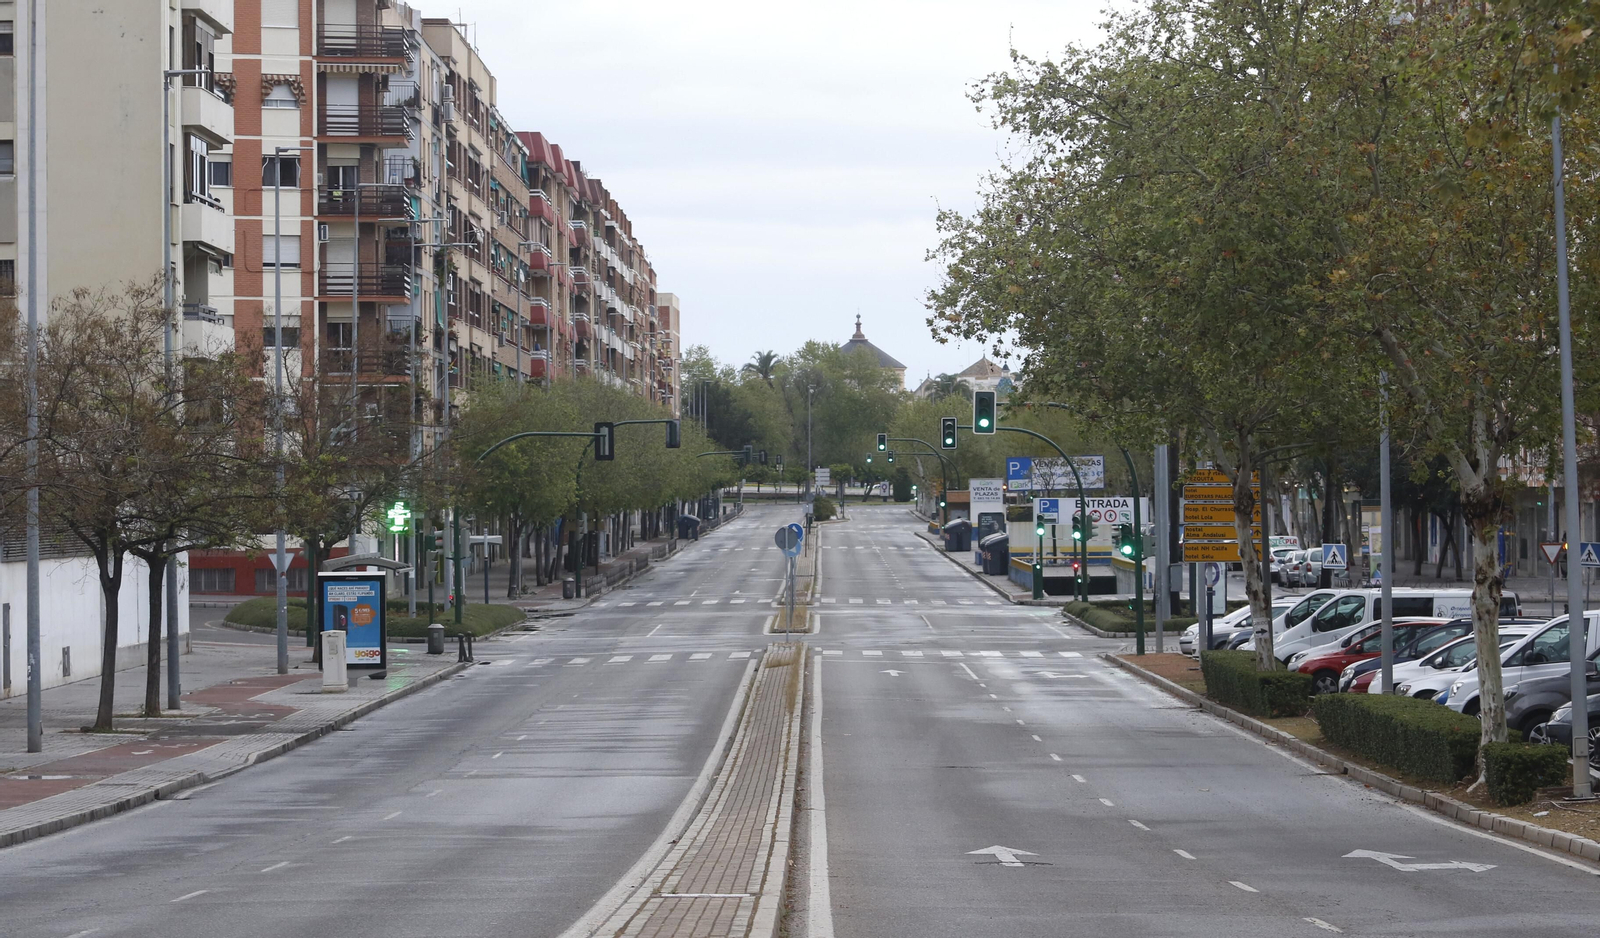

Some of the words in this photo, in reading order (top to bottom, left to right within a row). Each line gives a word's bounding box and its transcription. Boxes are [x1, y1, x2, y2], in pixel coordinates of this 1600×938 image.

[1009, 461, 1020, 475] P
[1040, 500, 1050, 512] P
[1075, 499, 1129, 508] ENTRADA
[355, 650, 381, 658] yoigo
